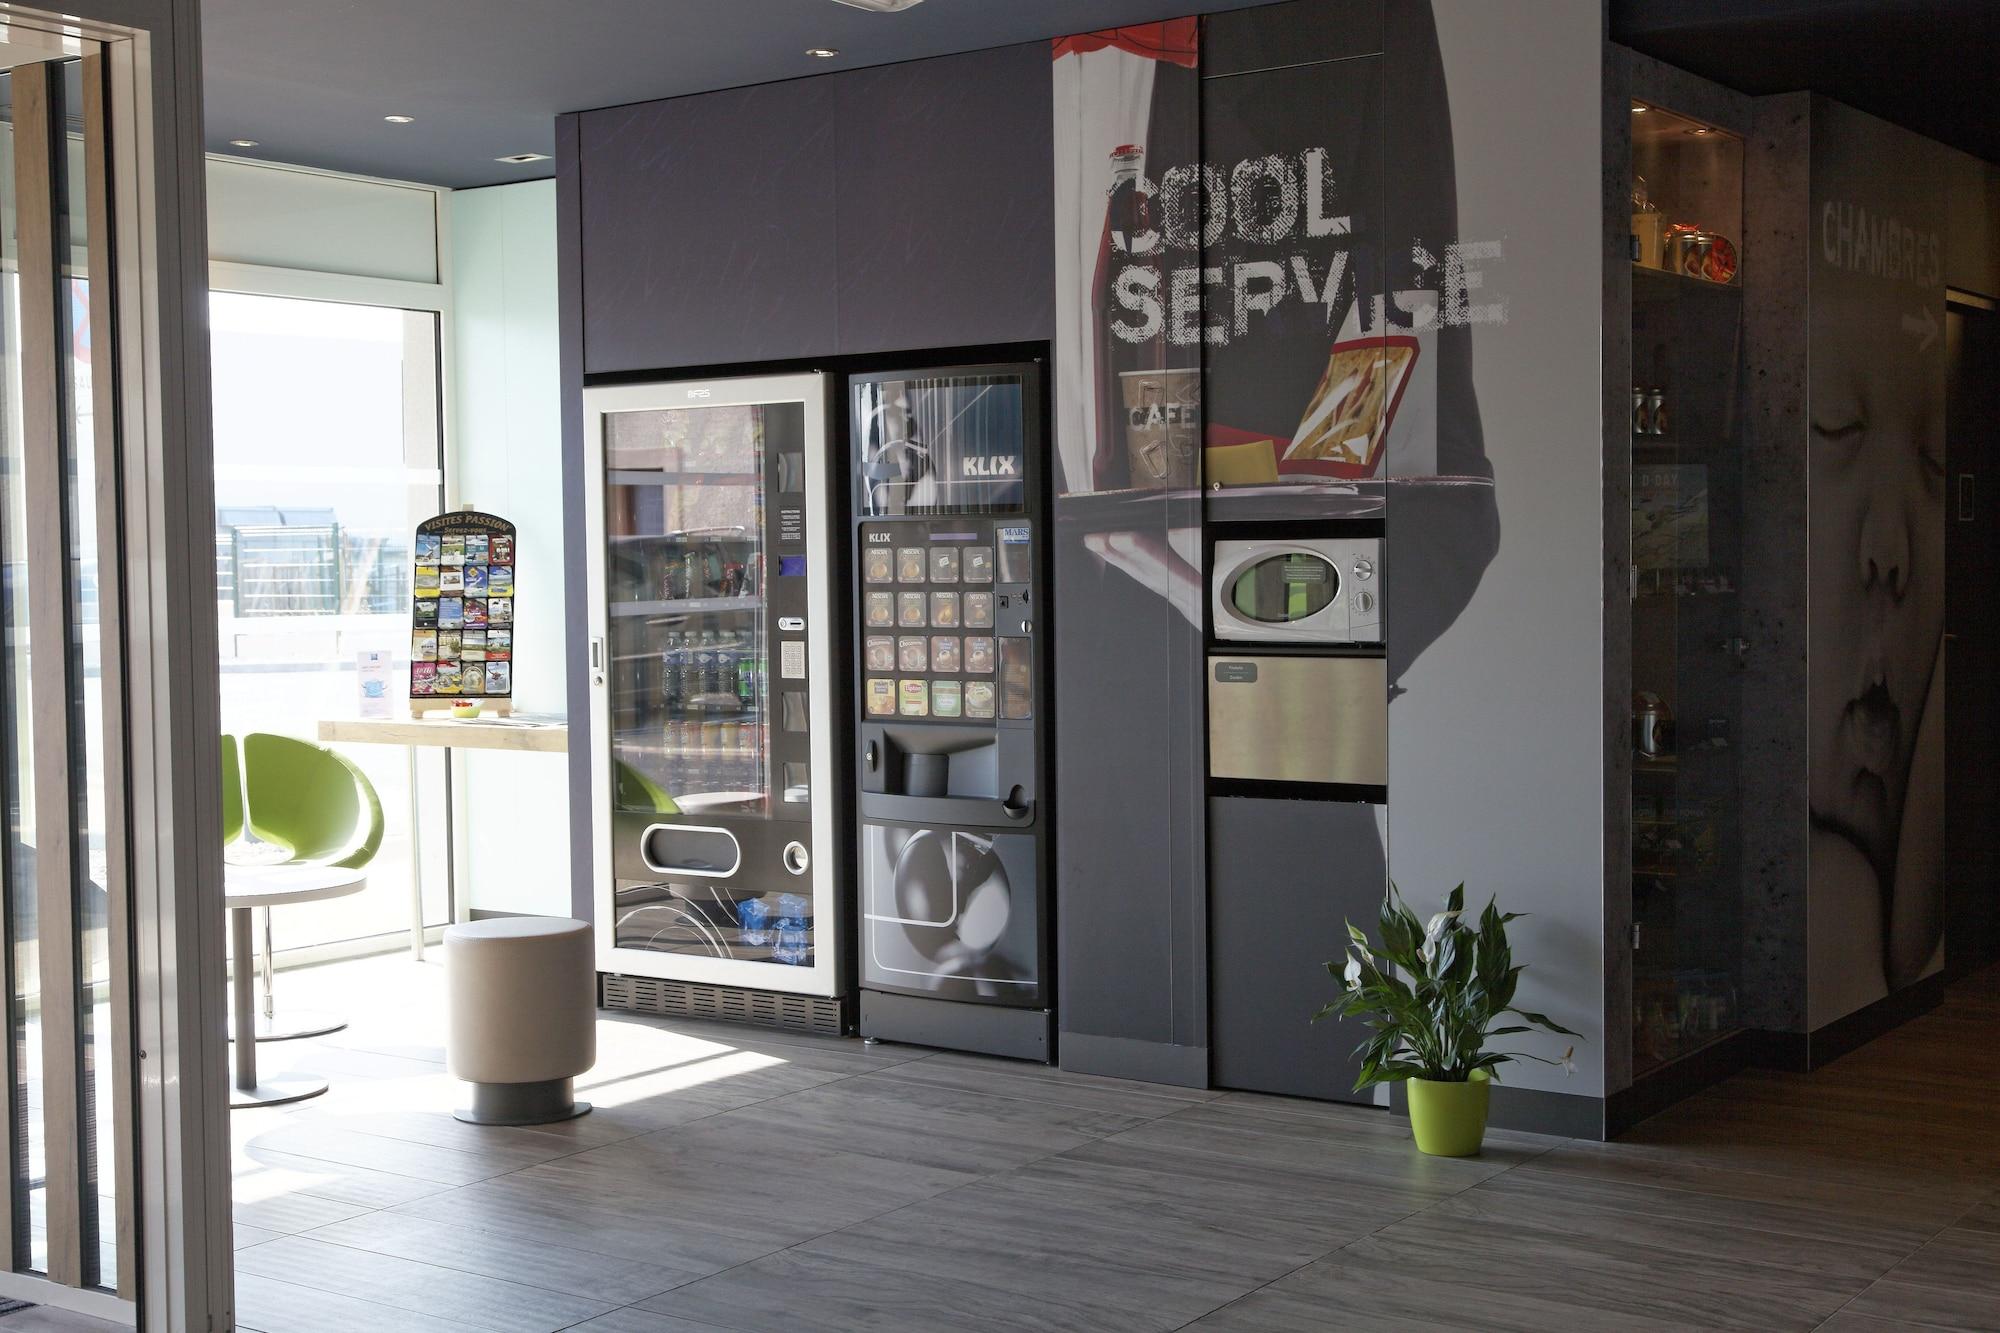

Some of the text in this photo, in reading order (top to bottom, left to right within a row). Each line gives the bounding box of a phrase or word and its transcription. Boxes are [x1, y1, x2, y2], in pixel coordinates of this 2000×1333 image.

[1106, 146, 1351, 254] COOL
[1823, 201, 1940, 286] CHAMBRES
[963, 455, 1015, 476] KLIX
[425, 515, 509, 531] VISITES PASSION
[1005, 528, 1029, 536] MARS
[869, 533, 891, 543] KLIX
